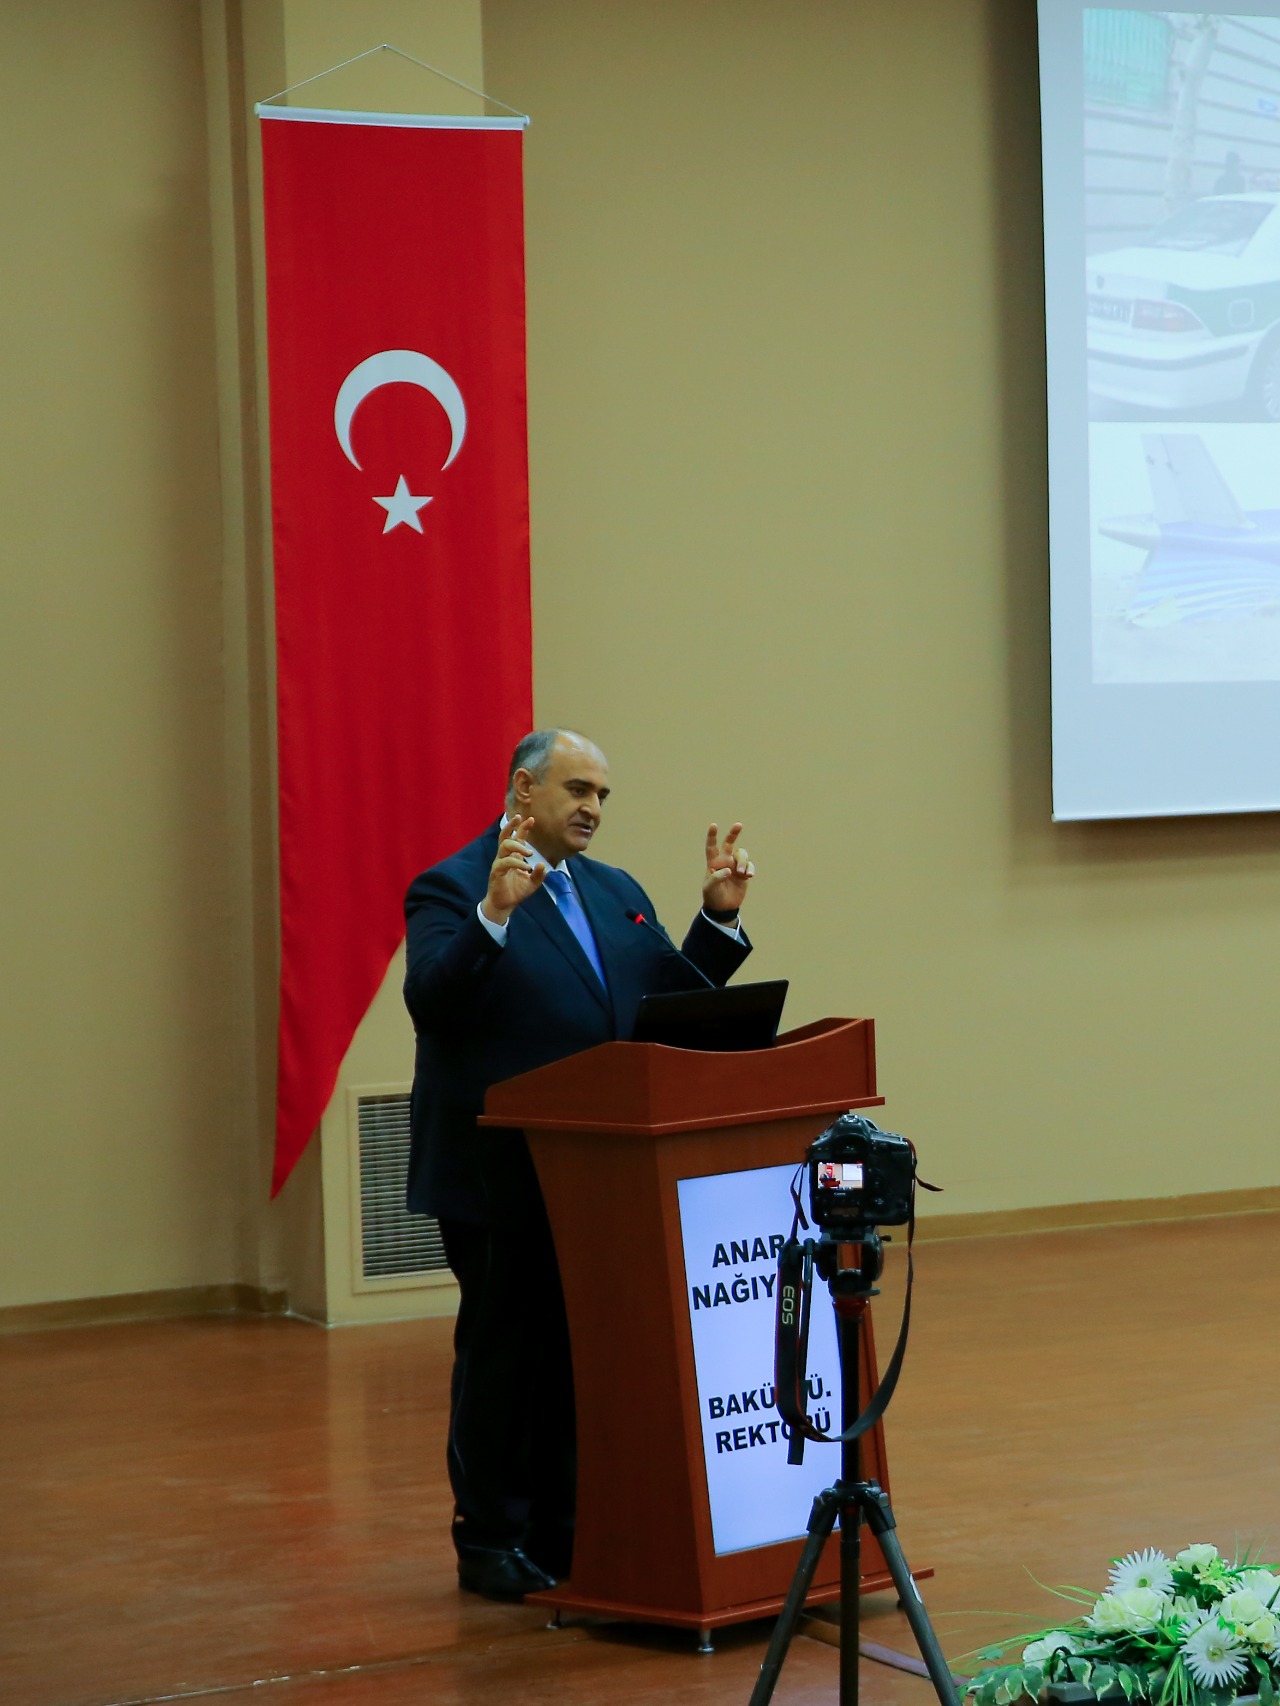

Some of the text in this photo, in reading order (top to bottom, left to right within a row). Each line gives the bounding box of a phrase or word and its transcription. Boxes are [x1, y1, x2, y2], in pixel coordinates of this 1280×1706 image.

[712, 1234, 785, 1268] ANAR
[692, 1273, 777, 1310] NAĞIY
[782, 1285, 795, 1325] EOS
[709, 1382, 776, 1419] BAKÜ
[716, 1407, 831, 1453] REKTÜ
